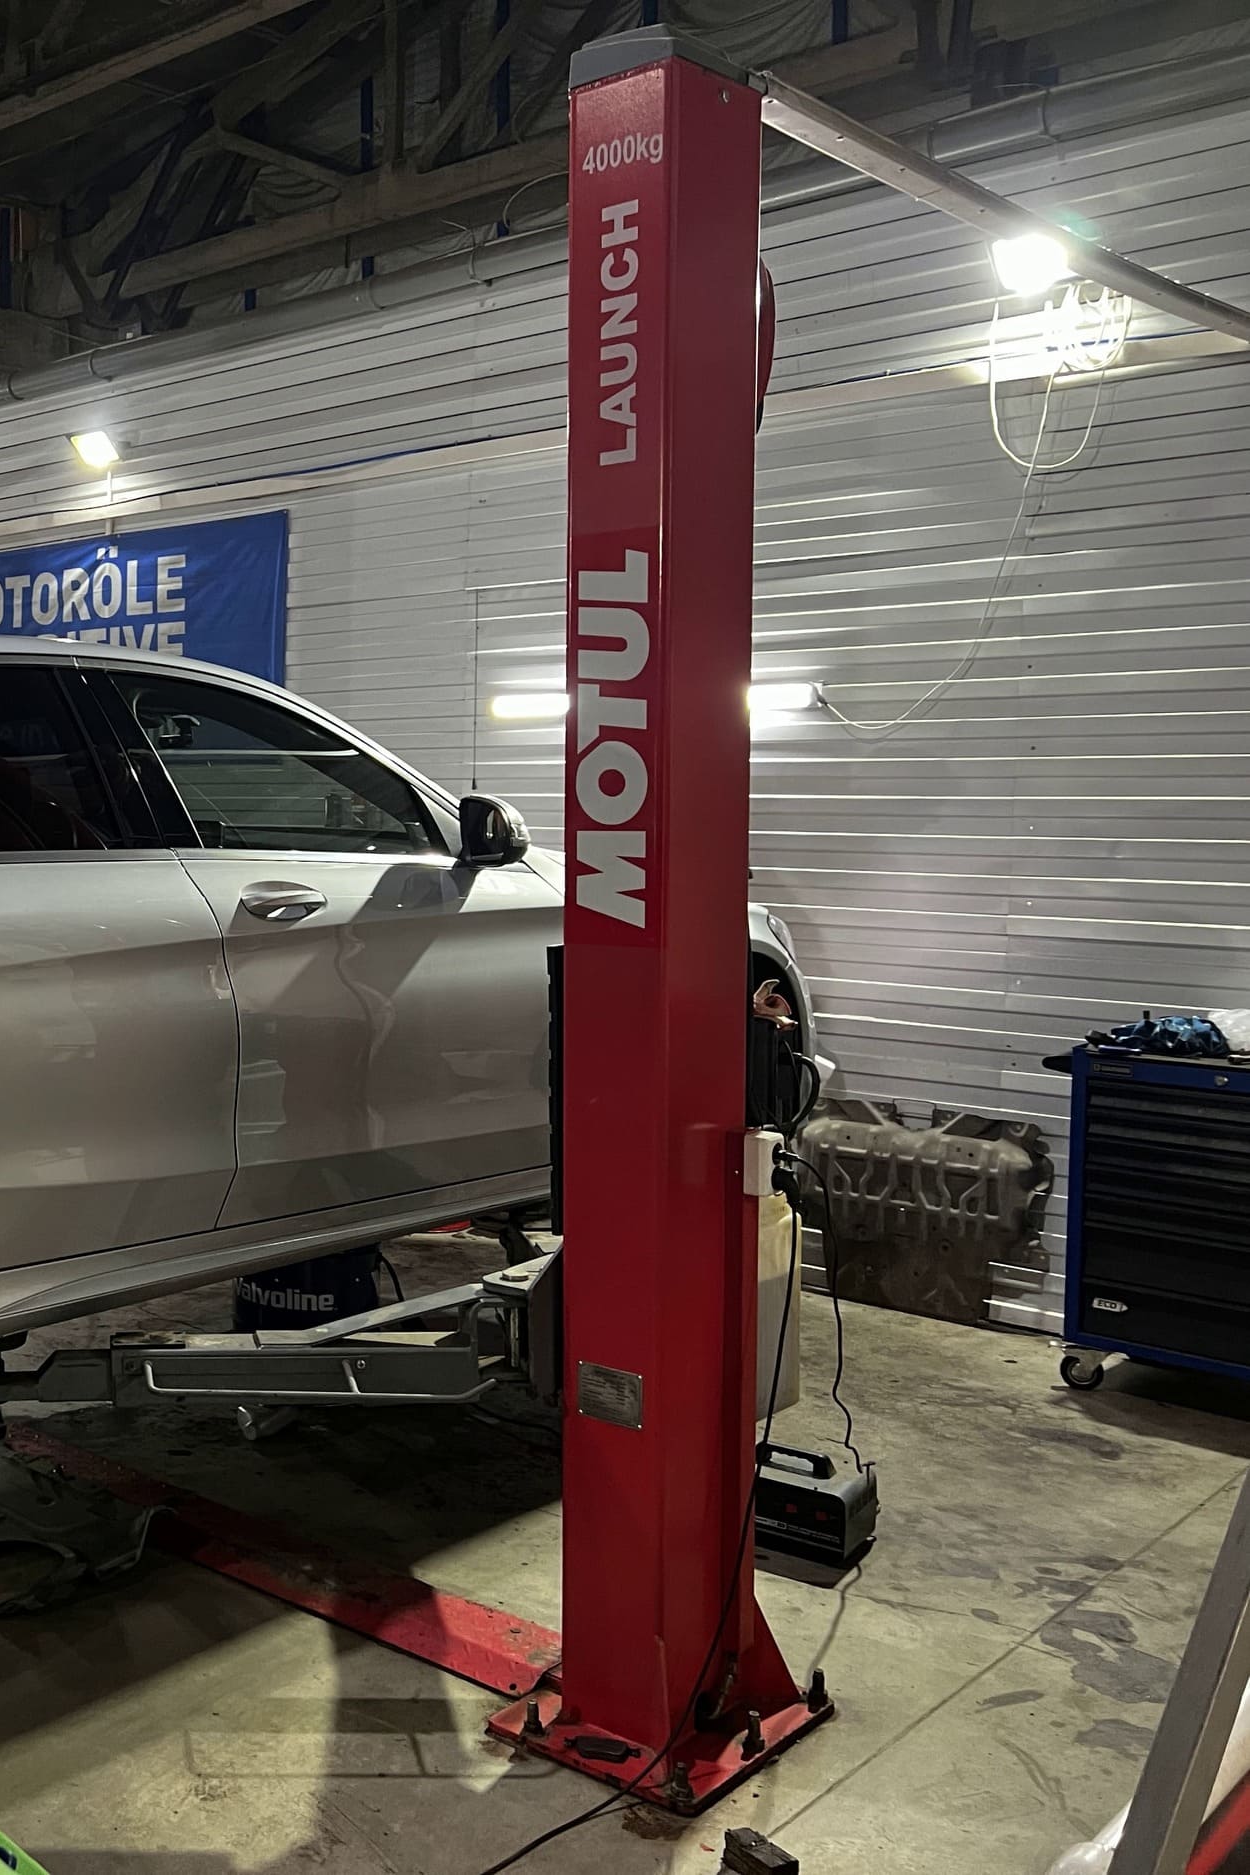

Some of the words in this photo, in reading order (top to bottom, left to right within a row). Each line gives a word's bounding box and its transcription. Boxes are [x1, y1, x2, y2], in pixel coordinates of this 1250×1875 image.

[582, 131, 664, 175] 4000kg
[599, 198, 639, 467] LAUNCH
[575, 548, 650, 929] MOTUL
[234, 1277, 335, 1311] Valvoline
[1097, 1299, 1117, 1309] ECO
